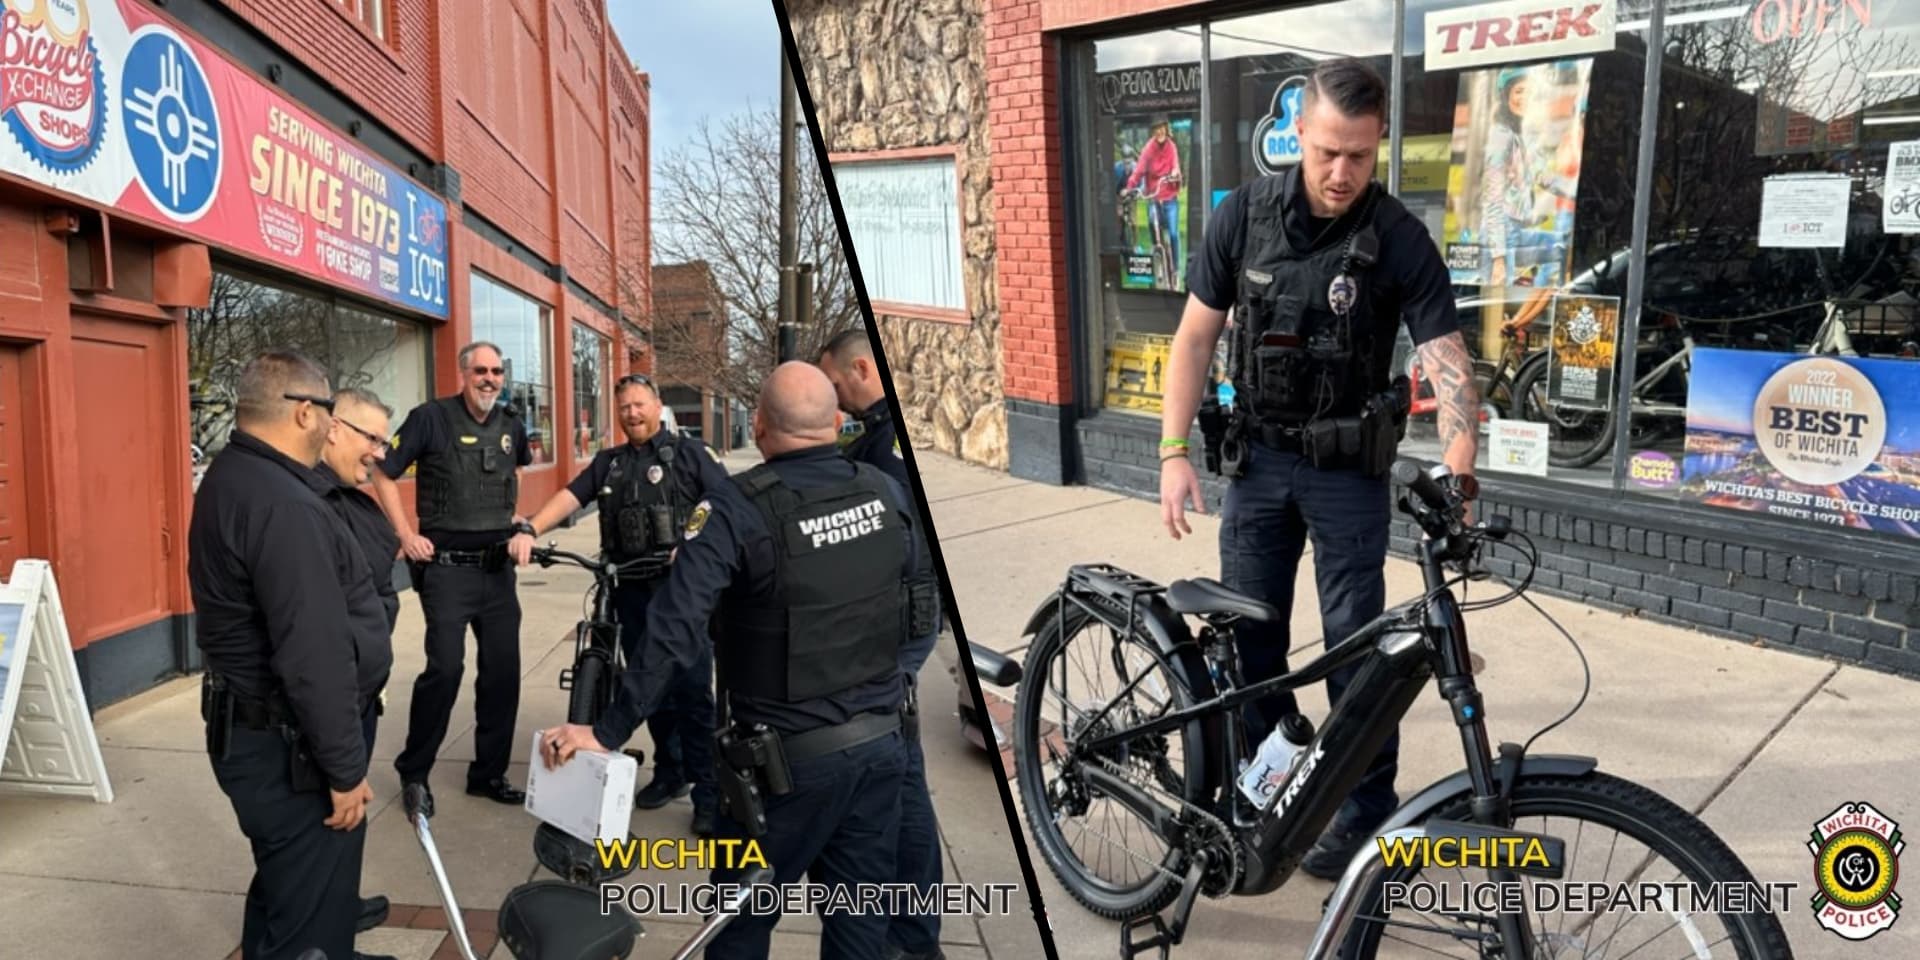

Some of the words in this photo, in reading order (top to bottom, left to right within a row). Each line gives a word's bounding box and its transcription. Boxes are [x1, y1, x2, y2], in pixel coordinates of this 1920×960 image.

[1436, 3, 1602, 54] TREK
[7, 71, 83, 107] X-CHANGE
[39, 109, 89, 146] SHOPS
[268, 105, 334, 166] SERVING
[336, 148, 388, 199] WICHITA
[250, 134, 344, 231] SINCE
[350, 190, 400, 256] 1973
[1803, 222, 1824, 233] ICT
[408, 247, 446, 306] ICT
[1787, 383, 1854, 409] WINNER
[1806, 370, 1837, 387] 2022
[1768, 405, 1869, 439] BEST
[1774, 431, 1793, 449] OF
[1797, 434, 1859, 457] WICHITA
[1704, 479, 1775, 501] WICHITA'S
[1775, 489, 1814, 506] BEST
[1815, 493, 1879, 516] BICYCLE
[1768, 505, 1813, 520] SINCE
[798, 499, 886, 535] WICHITA
[811, 515, 884, 548] POLICE
[1271, 739, 1325, 819] TREK
